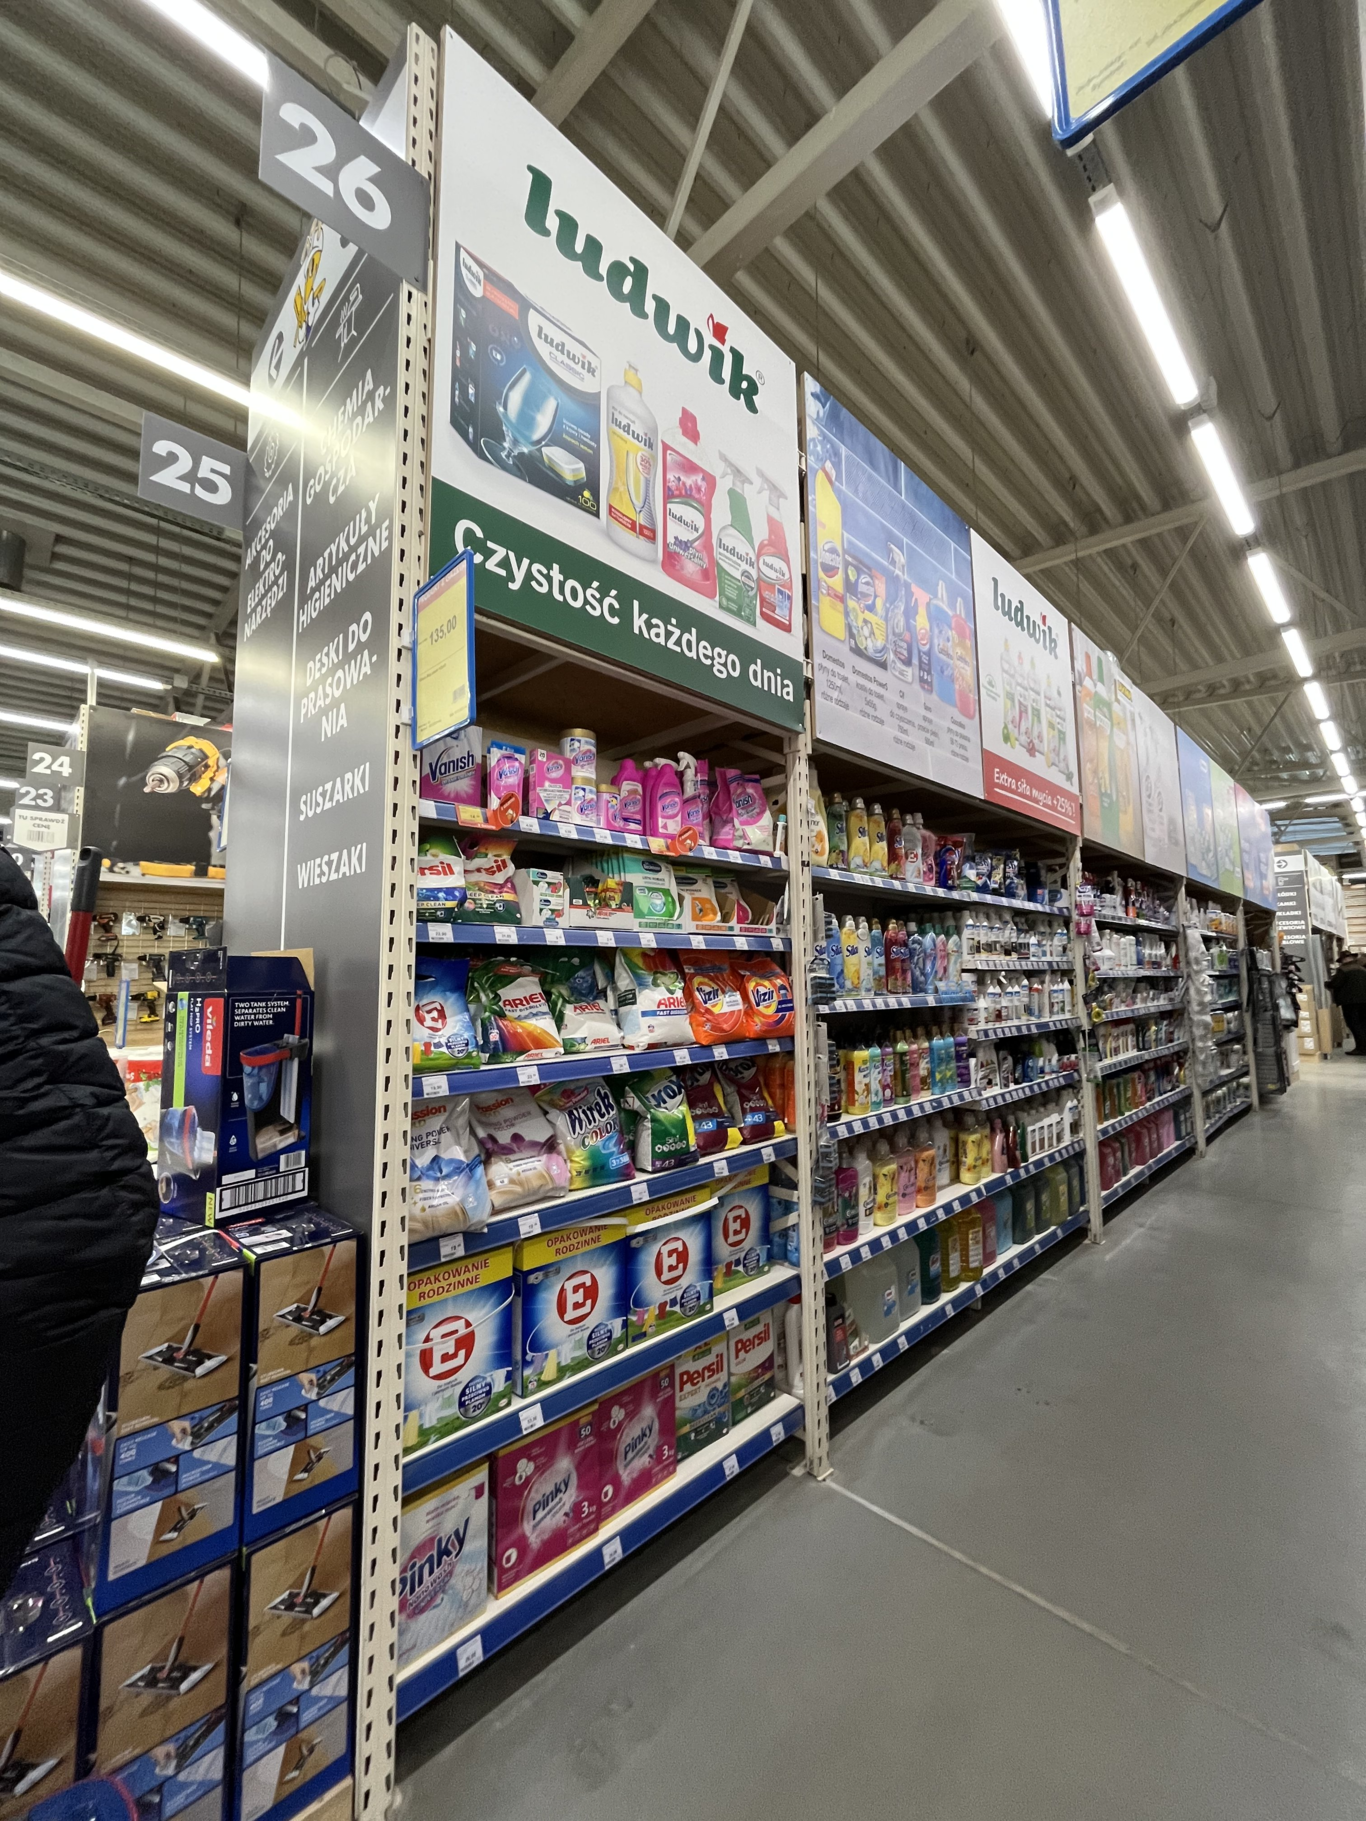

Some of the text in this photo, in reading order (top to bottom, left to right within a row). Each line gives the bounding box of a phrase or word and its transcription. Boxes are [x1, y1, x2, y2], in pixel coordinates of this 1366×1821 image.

[275, 102, 392, 230] 26
[524, 164, 759, 414] ludwik
[537, 324, 596, 378] ludwik
[611, 410, 654, 451] ludwik
[149, 439, 233, 505] 25
[328, 455, 356, 505] CZA
[577, 495, 597, 511] 100
[668, 507, 700, 534] ludwik
[244, 482, 295, 570] AKCESORIA
[306, 493, 380, 595] ARTYKUŁY
[259, 538, 274, 572] DO
[453, 519, 621, 625] Czystość
[718, 537, 756, 569] ludwik
[246, 552, 287, 615] ELEKTRO-
[297, 519, 390, 634] HIGIENICZNE
[242, 570, 288, 642] NARZĘDZI
[991, 577, 1059, 660] ludwik
[306, 611, 372, 687] DESKI DO
[429, 615, 457, 646] 135,00
[632, 600, 794, 702] każdego dnia
[300, 649, 378, 724] PRASOWA-
[321, 702, 348, 742] NIA
[31, 751, 72, 777] 24
[429, 750, 474, 783] Vanish
[18, 785, 54, 807] 23
[299, 762, 370, 821] SUSZARKI
[993, 768, 1017, 791] Extra
[1016, 772, 1032, 795] siła
[1032, 787, 1053, 807] mycia
[297, 842, 367, 889] WIESZAKI
[696, 986, 719, 1005] Vizir
[750, 988, 775, 1008] Vizir
[590, 1037, 610, 1045] ARIEL
[206, 1196, 214, 1226] NEW
[645, 1194, 697, 1216] OPAKOWANIE
[546, 1225, 608, 1248] OPAKOWANIE
[554, 1235, 603, 1257] RODZINNE
[407, 1258, 490, 1292] OPAKOWANIE
[418, 1276, 481, 1302] RODZINNE
[563, 1272, 592, 1322] E
[428, 1318, 467, 1378] E
[734, 1322, 771, 1361] Persil
[465, 1382, 487, 1395] SILNY
[660, 1376, 670, 1388] 50
[678, 1353, 724, 1393] Persil
[580, 1425, 592, 1439] 50
[624, 1419, 655, 1462] Pinky
[661, 1445, 669, 1460] 3
[532, 1473, 571, 1521] Pinky
[581, 1501, 589, 1518] 3
